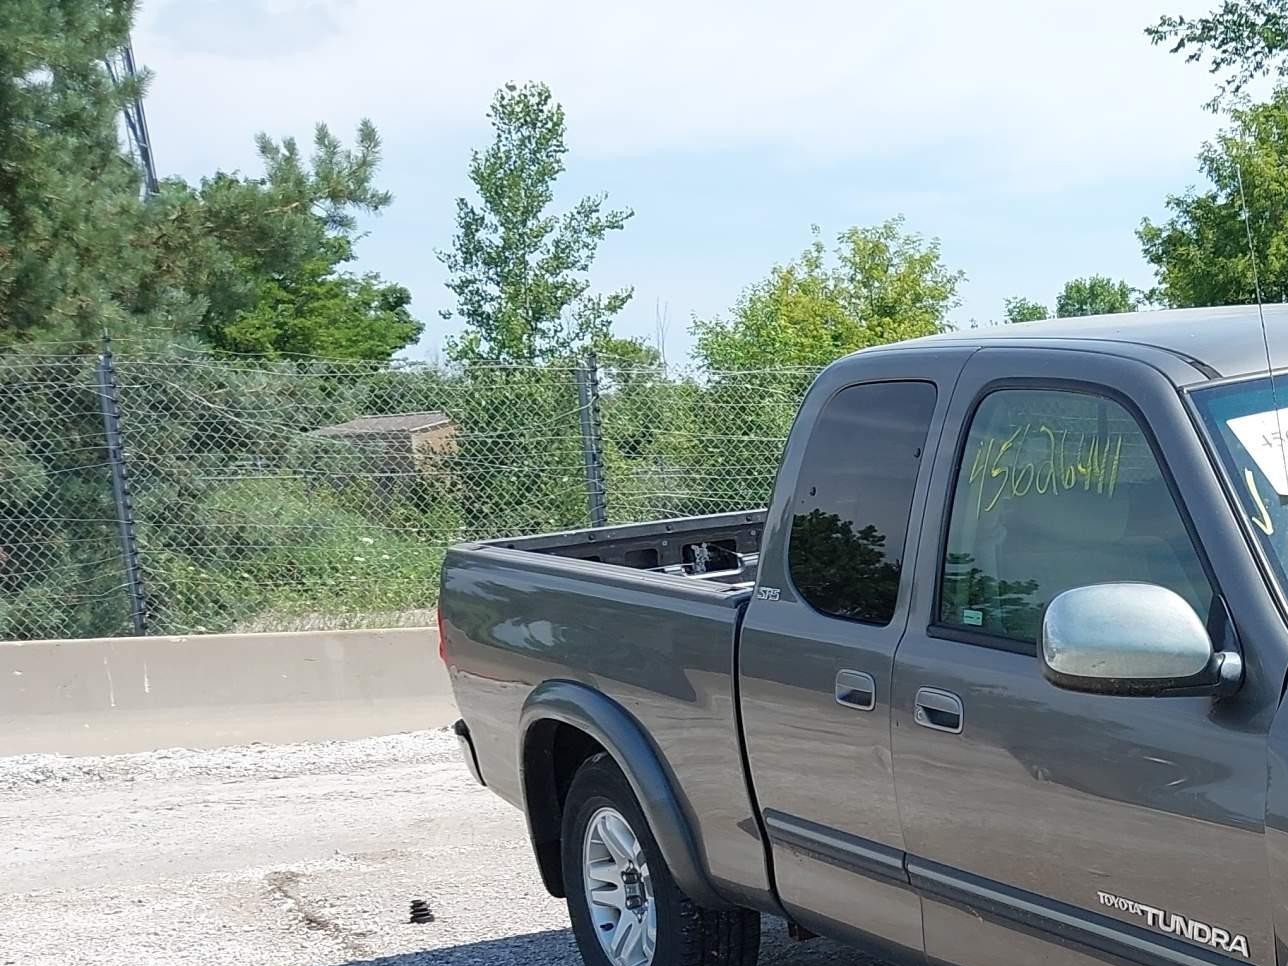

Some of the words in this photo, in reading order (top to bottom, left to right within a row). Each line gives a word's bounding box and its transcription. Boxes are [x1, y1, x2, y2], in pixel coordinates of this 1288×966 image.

[757, 587, 781, 601] SR5
[1097, 891, 1143, 916] TOYOTA
[1139, 904, 1250, 958] TUNDRA
